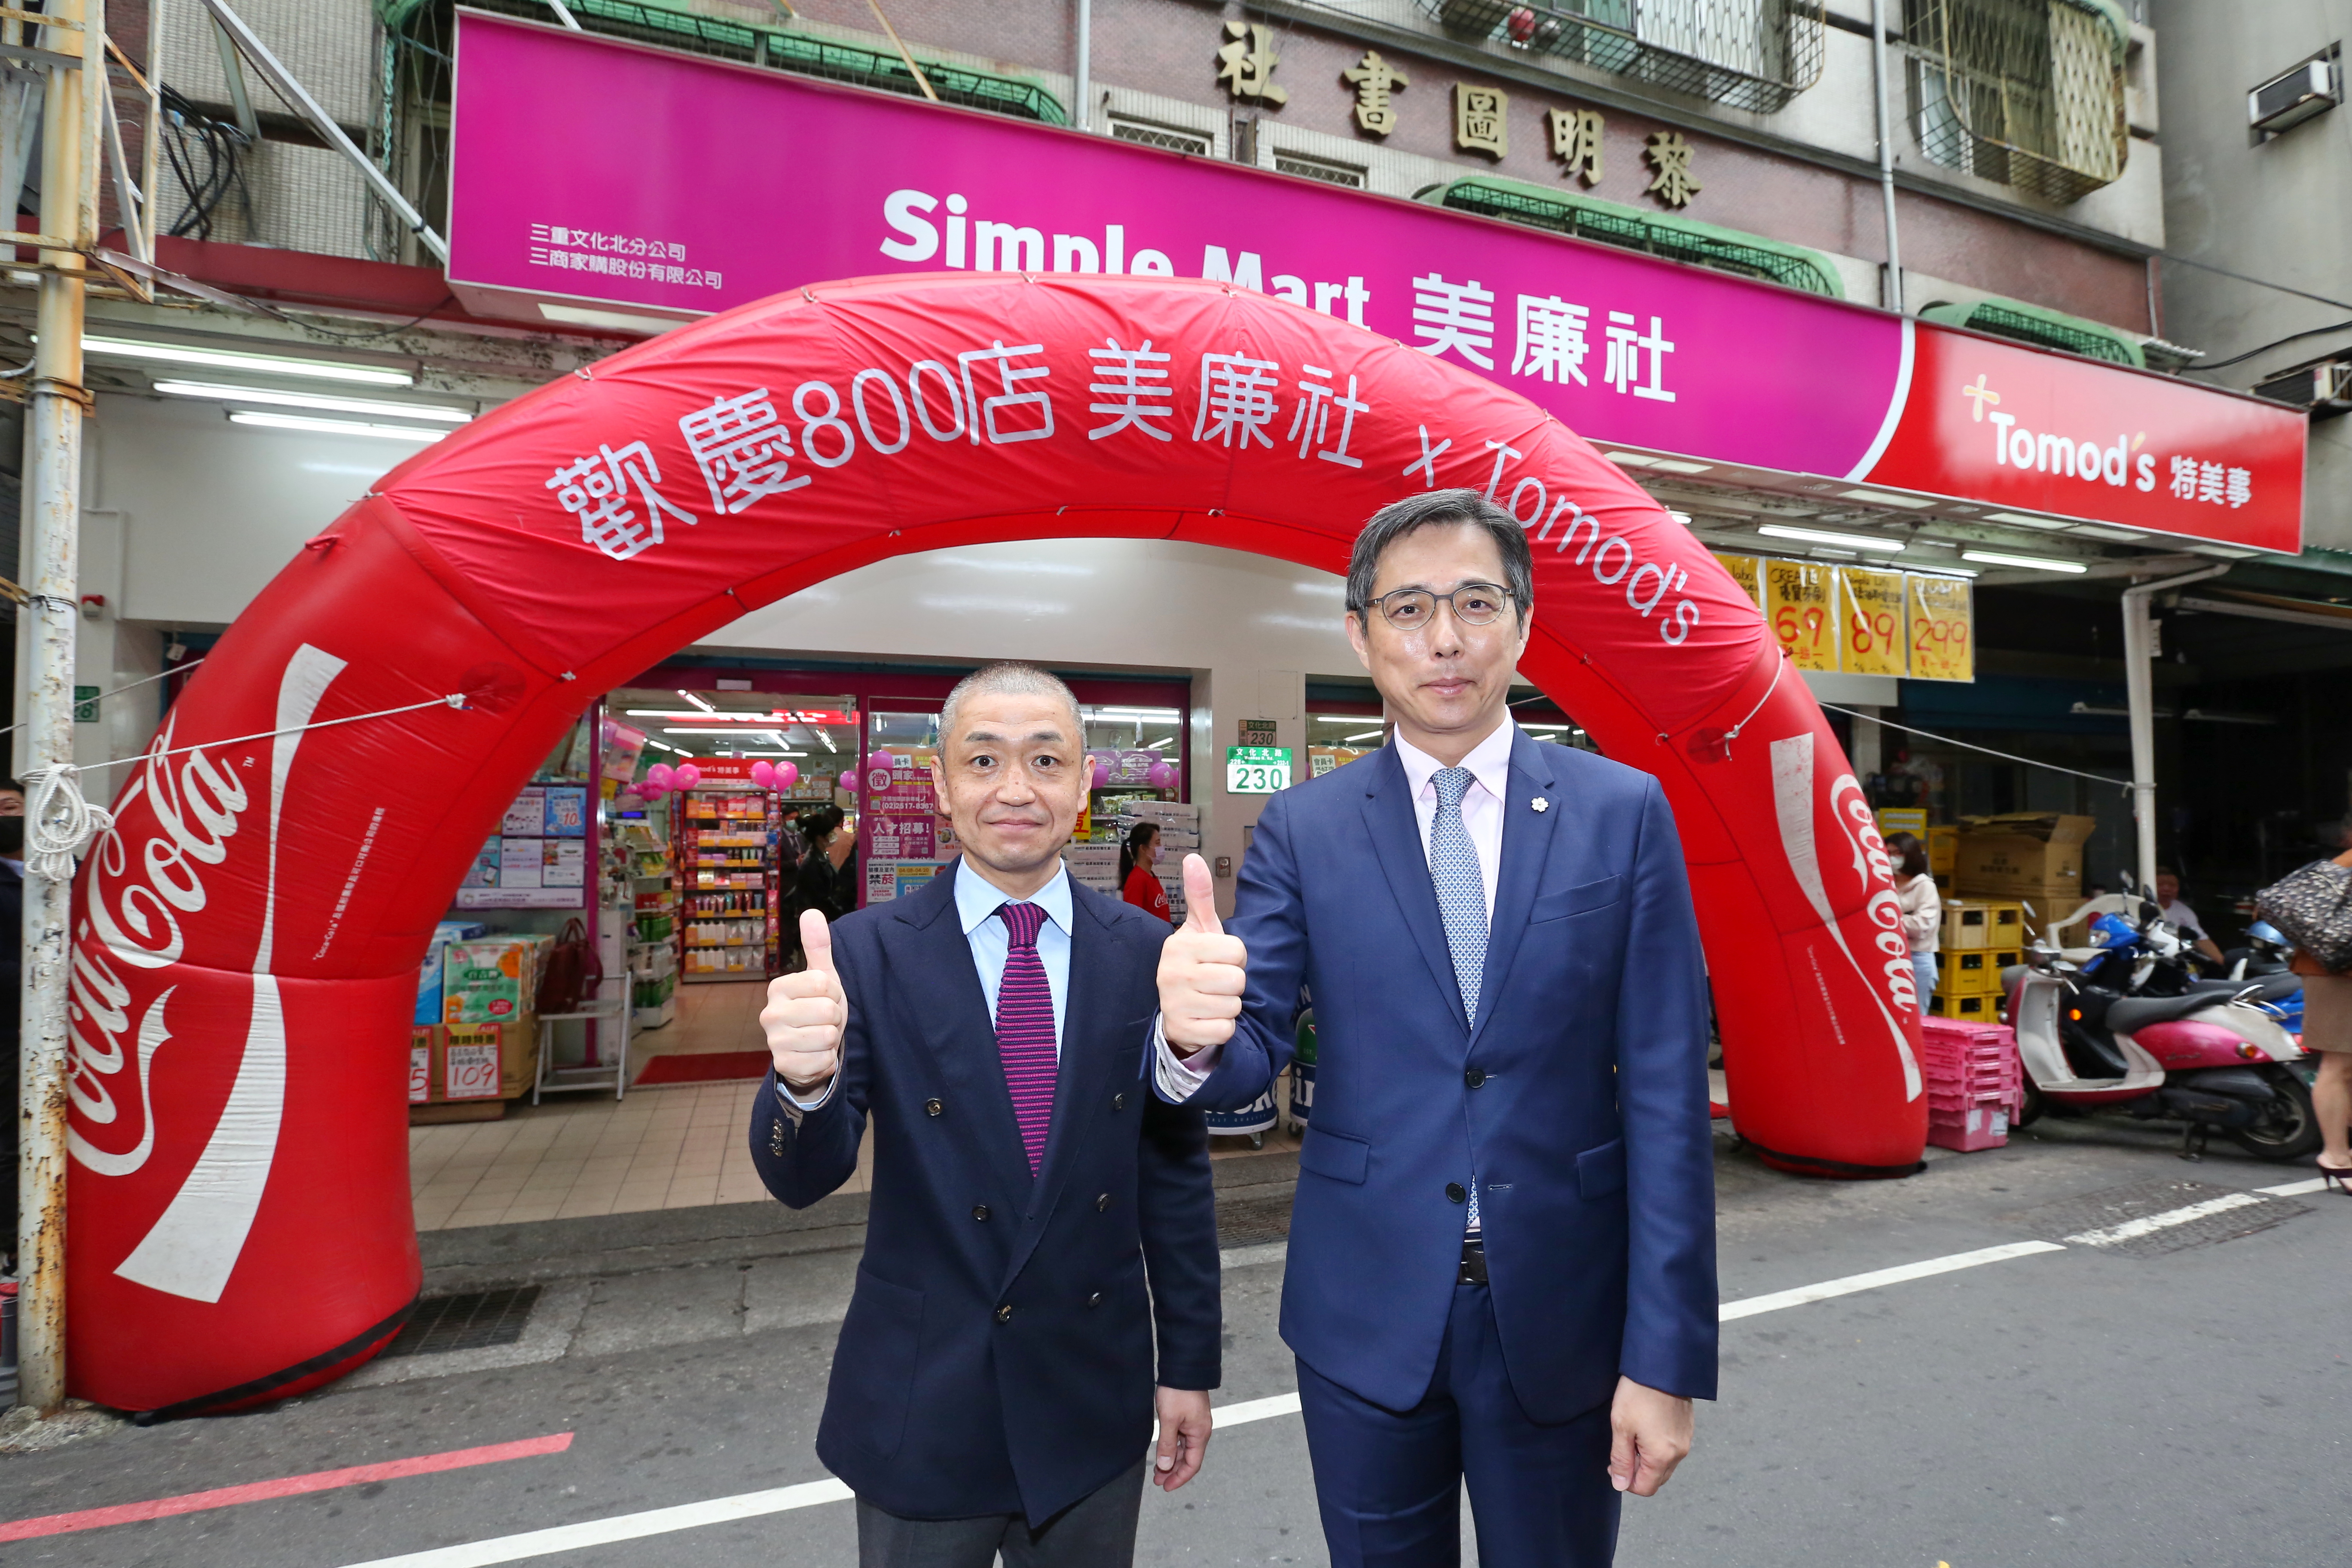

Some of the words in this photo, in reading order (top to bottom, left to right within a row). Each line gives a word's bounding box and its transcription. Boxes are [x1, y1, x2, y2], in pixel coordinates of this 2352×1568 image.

[529, 223, 686, 262] 三重文化北分公司
[529, 246, 722, 290] 三商家購股份有限公司
[1412, 271, 1676, 403] 美廉社
[1989, 411, 2156, 492] Tomod's
[2170, 455, 2252, 508] 特美事
[544, 339, 1055, 561] 歡慶800店
[1088, 337, 1370, 469] 美廉社
[1481, 439, 1700, 646] Tomod's
[1775, 605, 1824, 647] 69
[1851, 610, 1896, 655] 89
[1914, 617, 1968, 657] 299
[1236, 747, 1283, 757] 文化北路
[1251, 732, 1274, 745] 230
[1236, 767, 1283, 790] 230
[453, 1062, 496, 1087] 109
